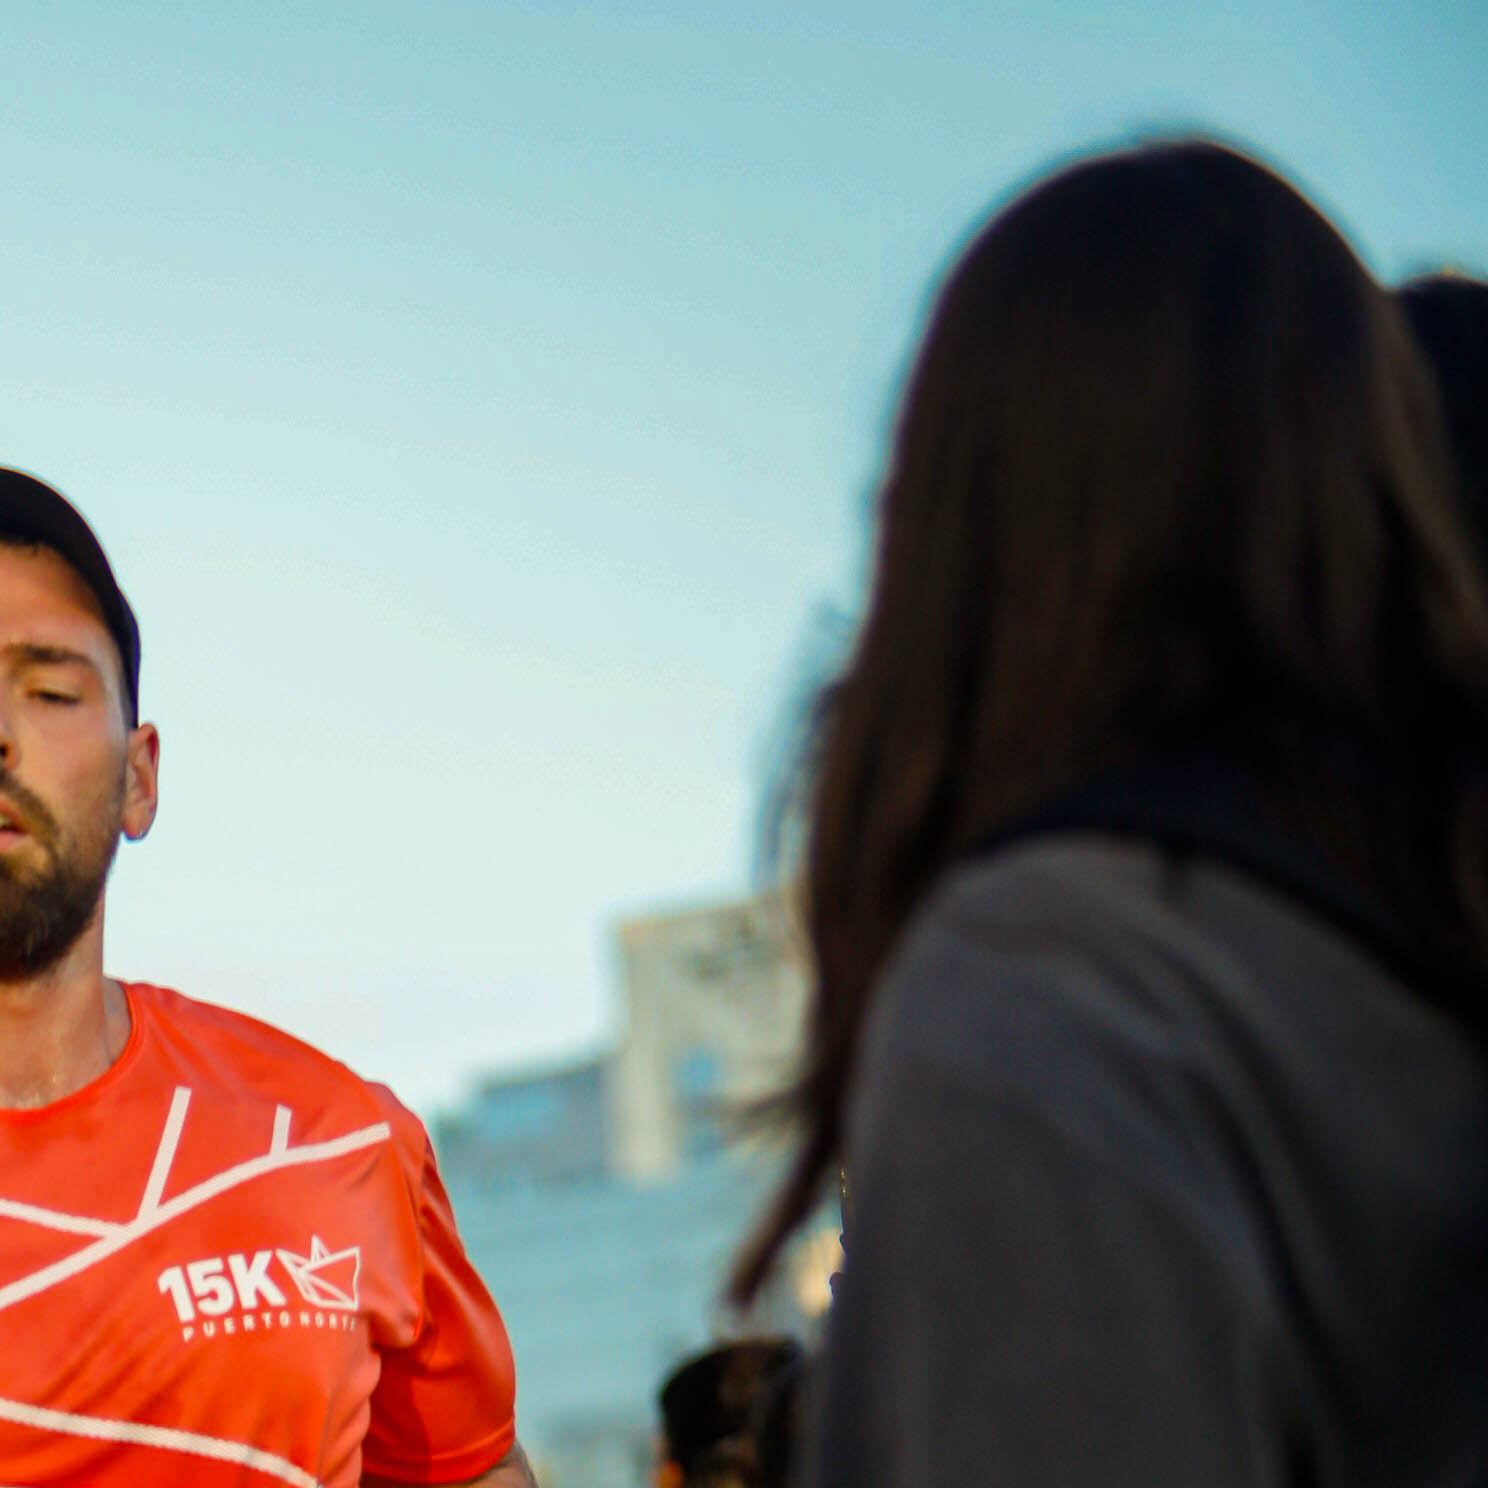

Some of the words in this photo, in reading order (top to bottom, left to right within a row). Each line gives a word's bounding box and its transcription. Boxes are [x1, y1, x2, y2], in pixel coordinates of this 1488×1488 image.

[158, 1250, 287, 1322] 15K
[183, 1311, 291, 1343] PUERTO
[300, 1311, 357, 1332] NORTE
